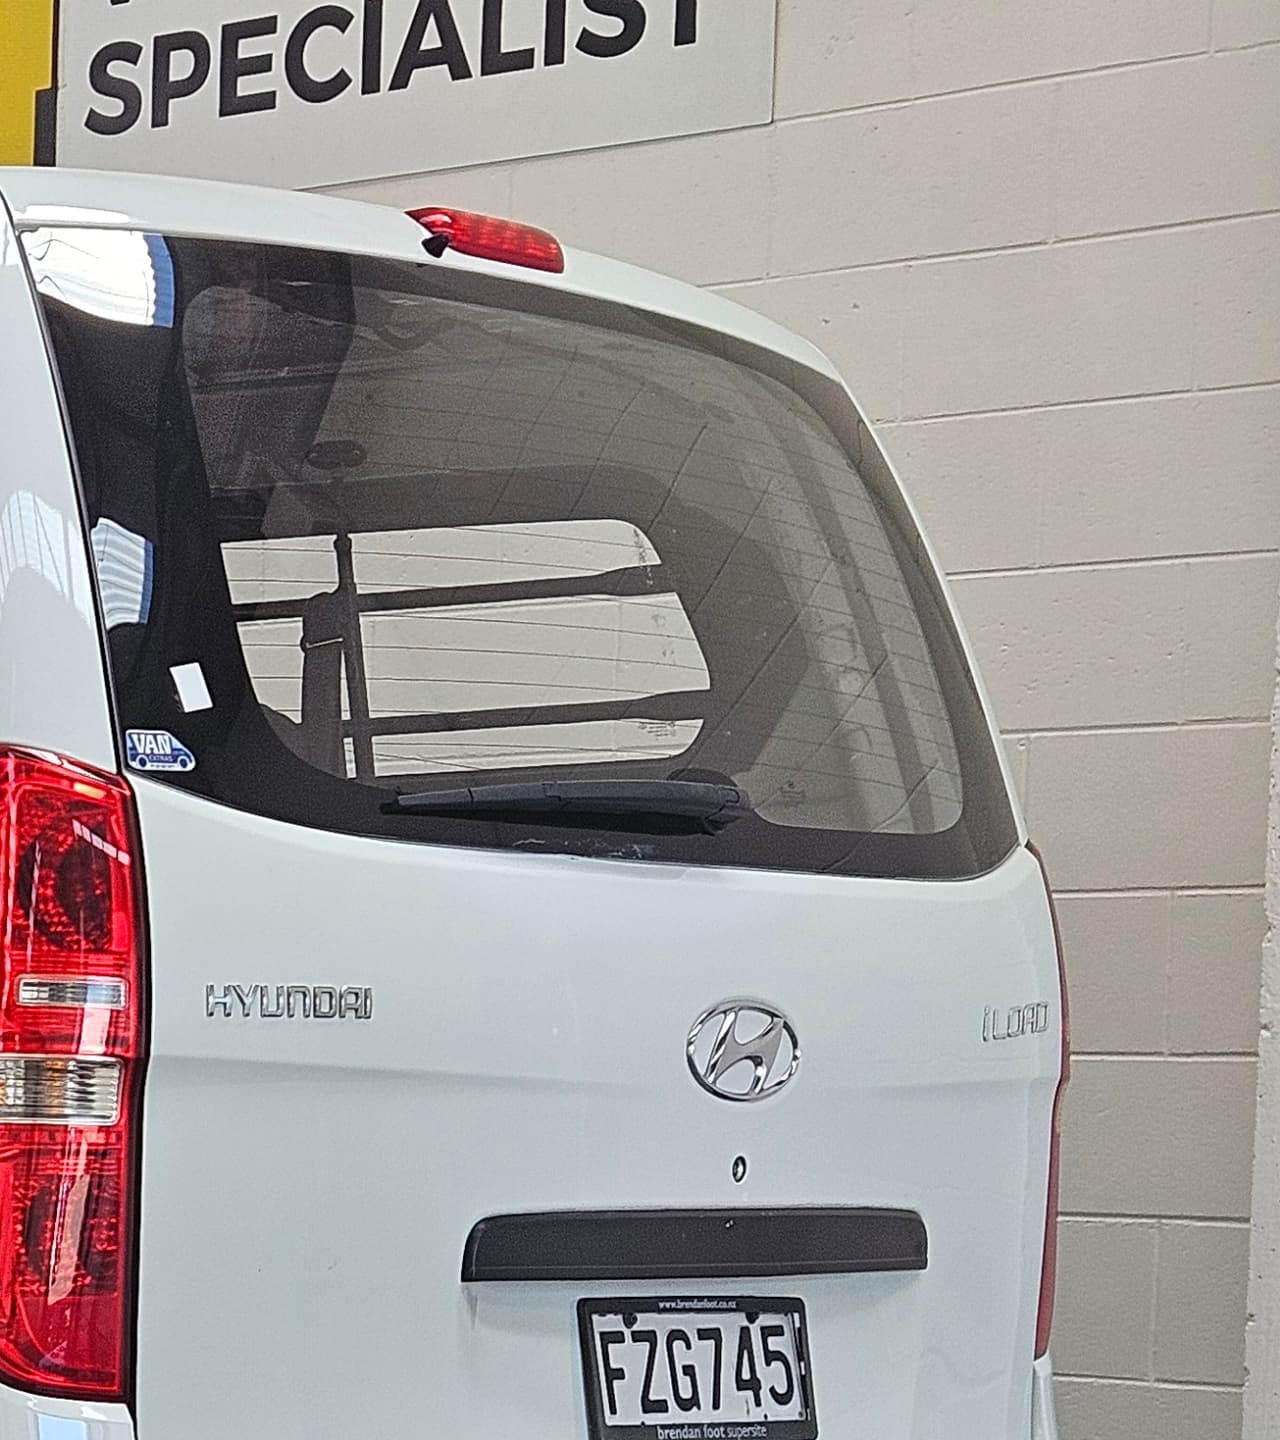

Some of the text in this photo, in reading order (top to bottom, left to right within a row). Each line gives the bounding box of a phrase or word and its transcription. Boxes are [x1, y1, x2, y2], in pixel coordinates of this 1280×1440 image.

[131, 734, 171, 754] VAN
[205, 984, 372, 1019] HYUNDAI
[599, 1324, 794, 1415] FZG745
[656, 1424, 701, 1440] brendan
[703, 1424, 725, 1439] foot
